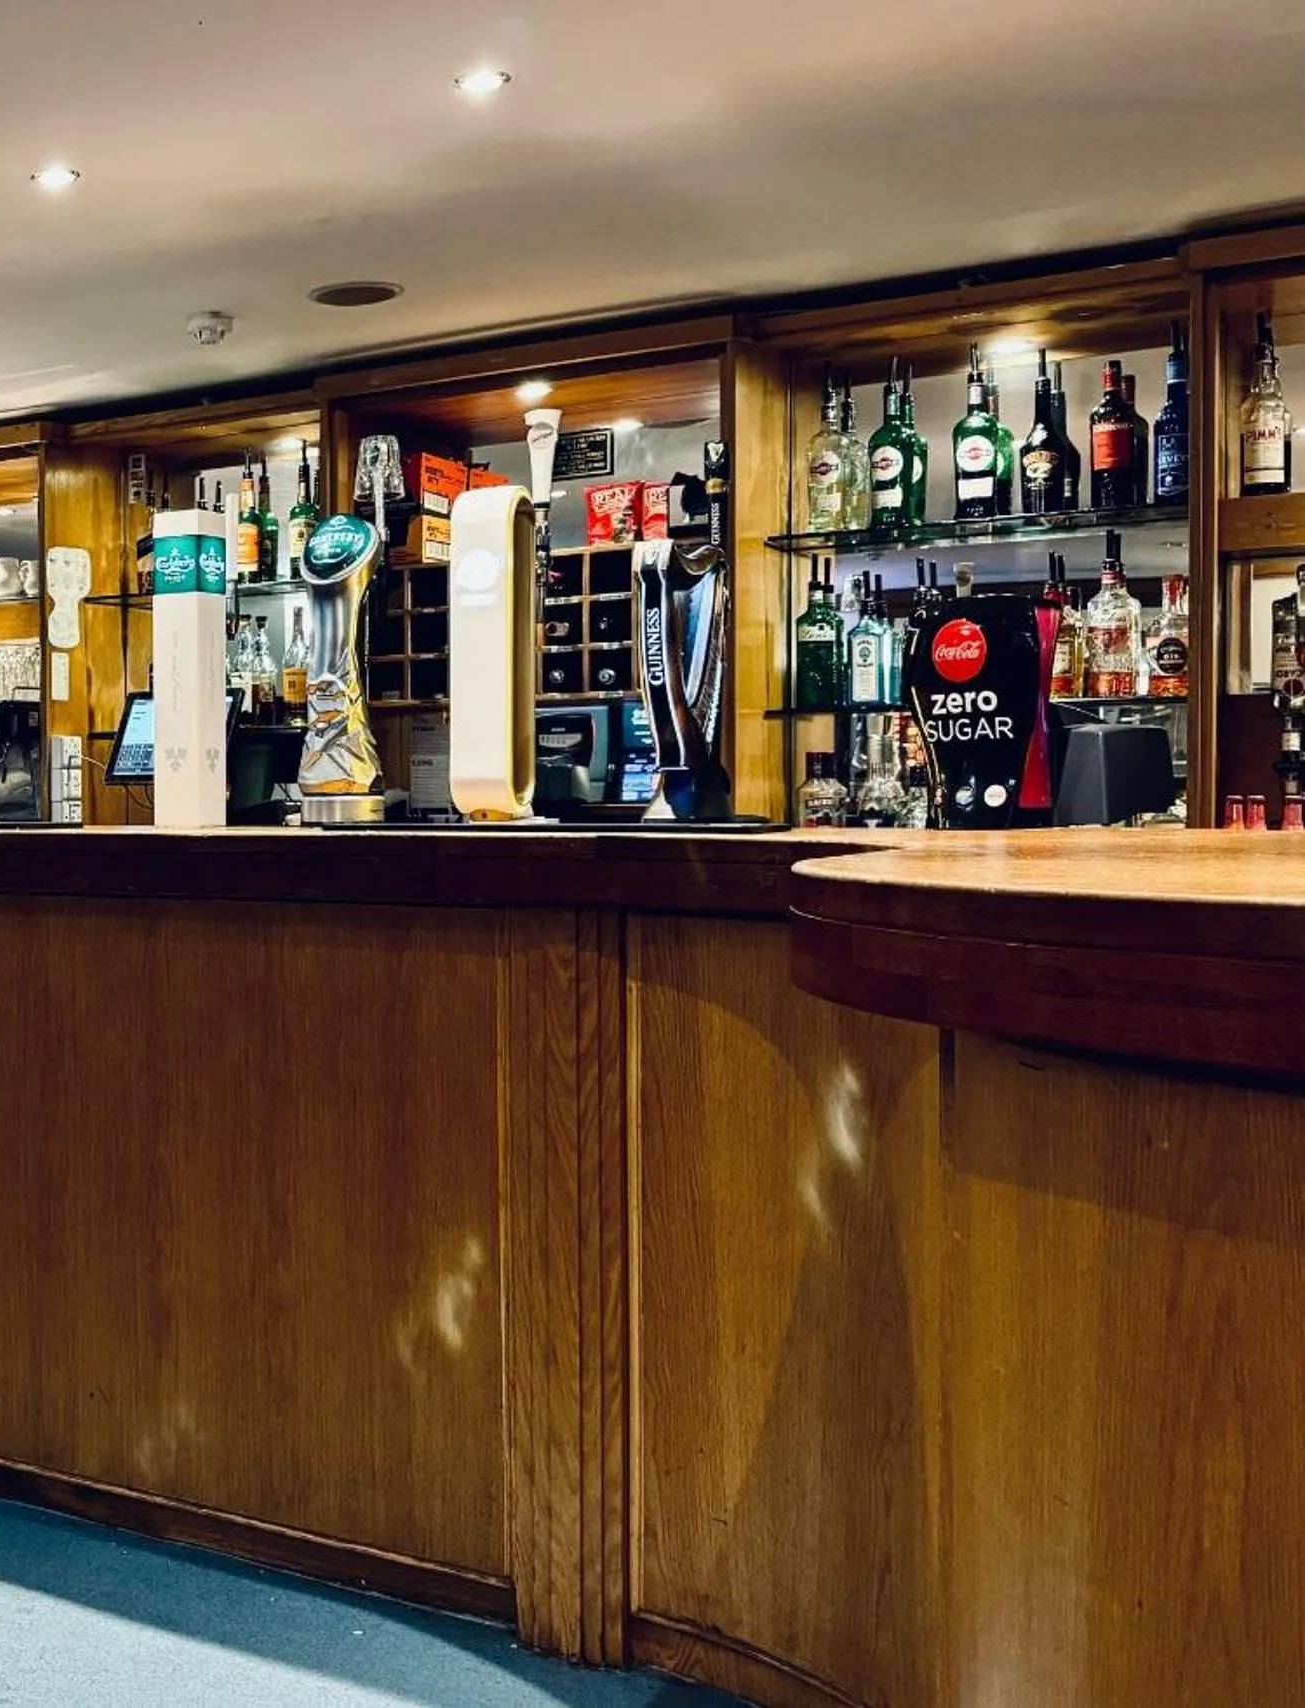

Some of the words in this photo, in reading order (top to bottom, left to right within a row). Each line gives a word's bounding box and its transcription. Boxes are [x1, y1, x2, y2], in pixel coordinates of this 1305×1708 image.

[710, 502, 721, 545] GUINNESS
[646, 607, 664, 686] GUINNESS
[930, 690, 998, 715] zero
[924, 717, 1014, 742] SUGAR
